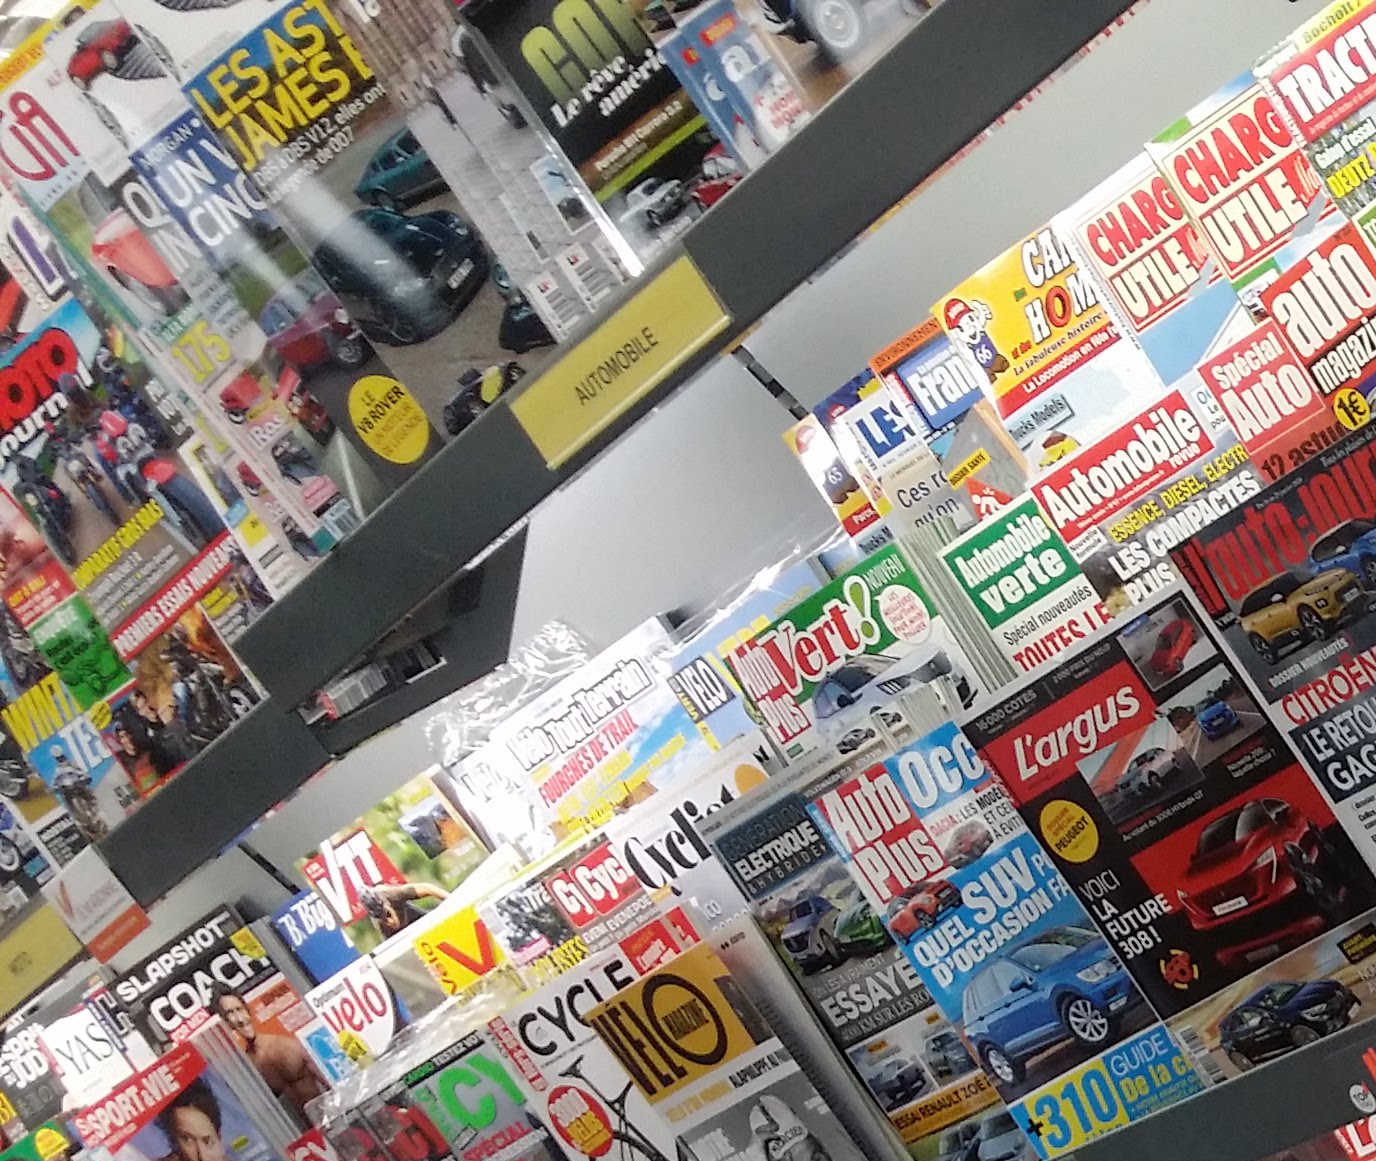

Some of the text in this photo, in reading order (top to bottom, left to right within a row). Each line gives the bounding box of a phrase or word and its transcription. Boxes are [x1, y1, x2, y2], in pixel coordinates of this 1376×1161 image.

[1204, 161, 1302, 265] UTILE
[574, 326, 659, 406] AUTOMOBILE
[1212, 331, 1281, 389] Spécial
[1221, 364, 1305, 442] Auto
[1048, 405, 1201, 525] Automobile
[954, 510, 1055, 589] Automobile
[1147, 472, 1262, 554] COMPACTES
[985, 551, 1069, 614] verte
[577, 654, 656, 726] Terrain
[1011, 685, 1141, 781] L'argus
[962, 846, 1040, 923] SUV
[1106, 895, 1174, 939] FUTURE
[116, 914, 235, 1001] SLAPSHOT
[913, 918, 977, 963] QUEL
[932, 892, 1053, 988] D'OCCASION
